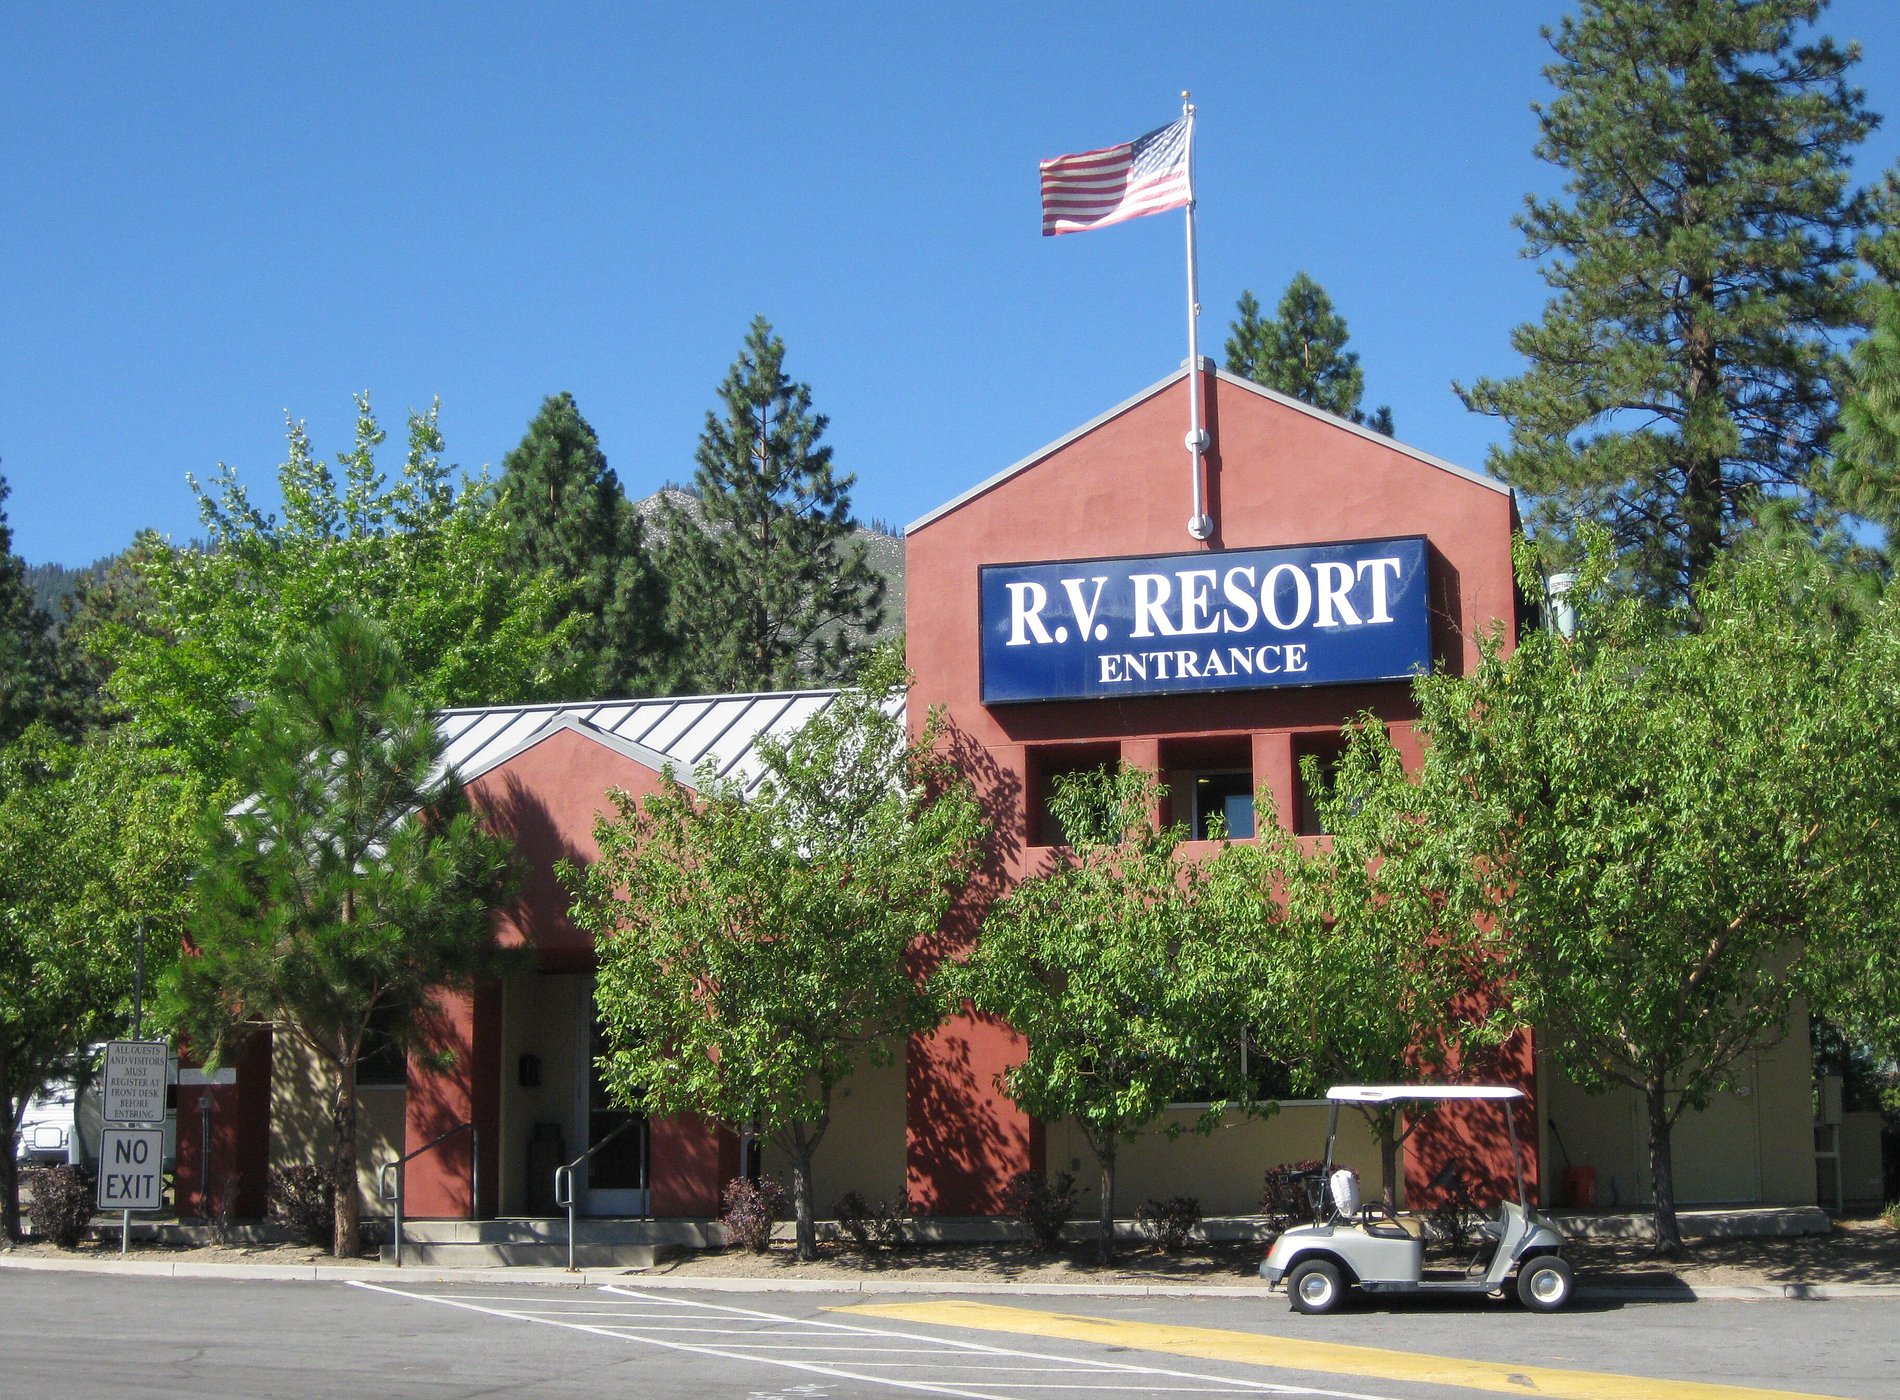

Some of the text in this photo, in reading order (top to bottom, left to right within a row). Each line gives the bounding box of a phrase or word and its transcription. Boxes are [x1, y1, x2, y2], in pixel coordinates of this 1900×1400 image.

[1005, 557, 1400, 646] R.V. RESORT
[1098, 643, 1308, 683] ENTRANCE
[115, 1046, 160, 1055] ALL GUESTS
[109, 1056, 164, 1065] AND VISITORS
[125, 1067, 147, 1076] MUST
[111, 1078, 160, 1087] REGISTER AT
[111, 1088, 159, 1098] FRONT DESK
[120, 1099, 149, 1108] BEFORE
[114, 1109, 154, 1119] ENTERING
[115, 1138, 148, 1164] NO
[106, 1174, 154, 1199] EXIT
